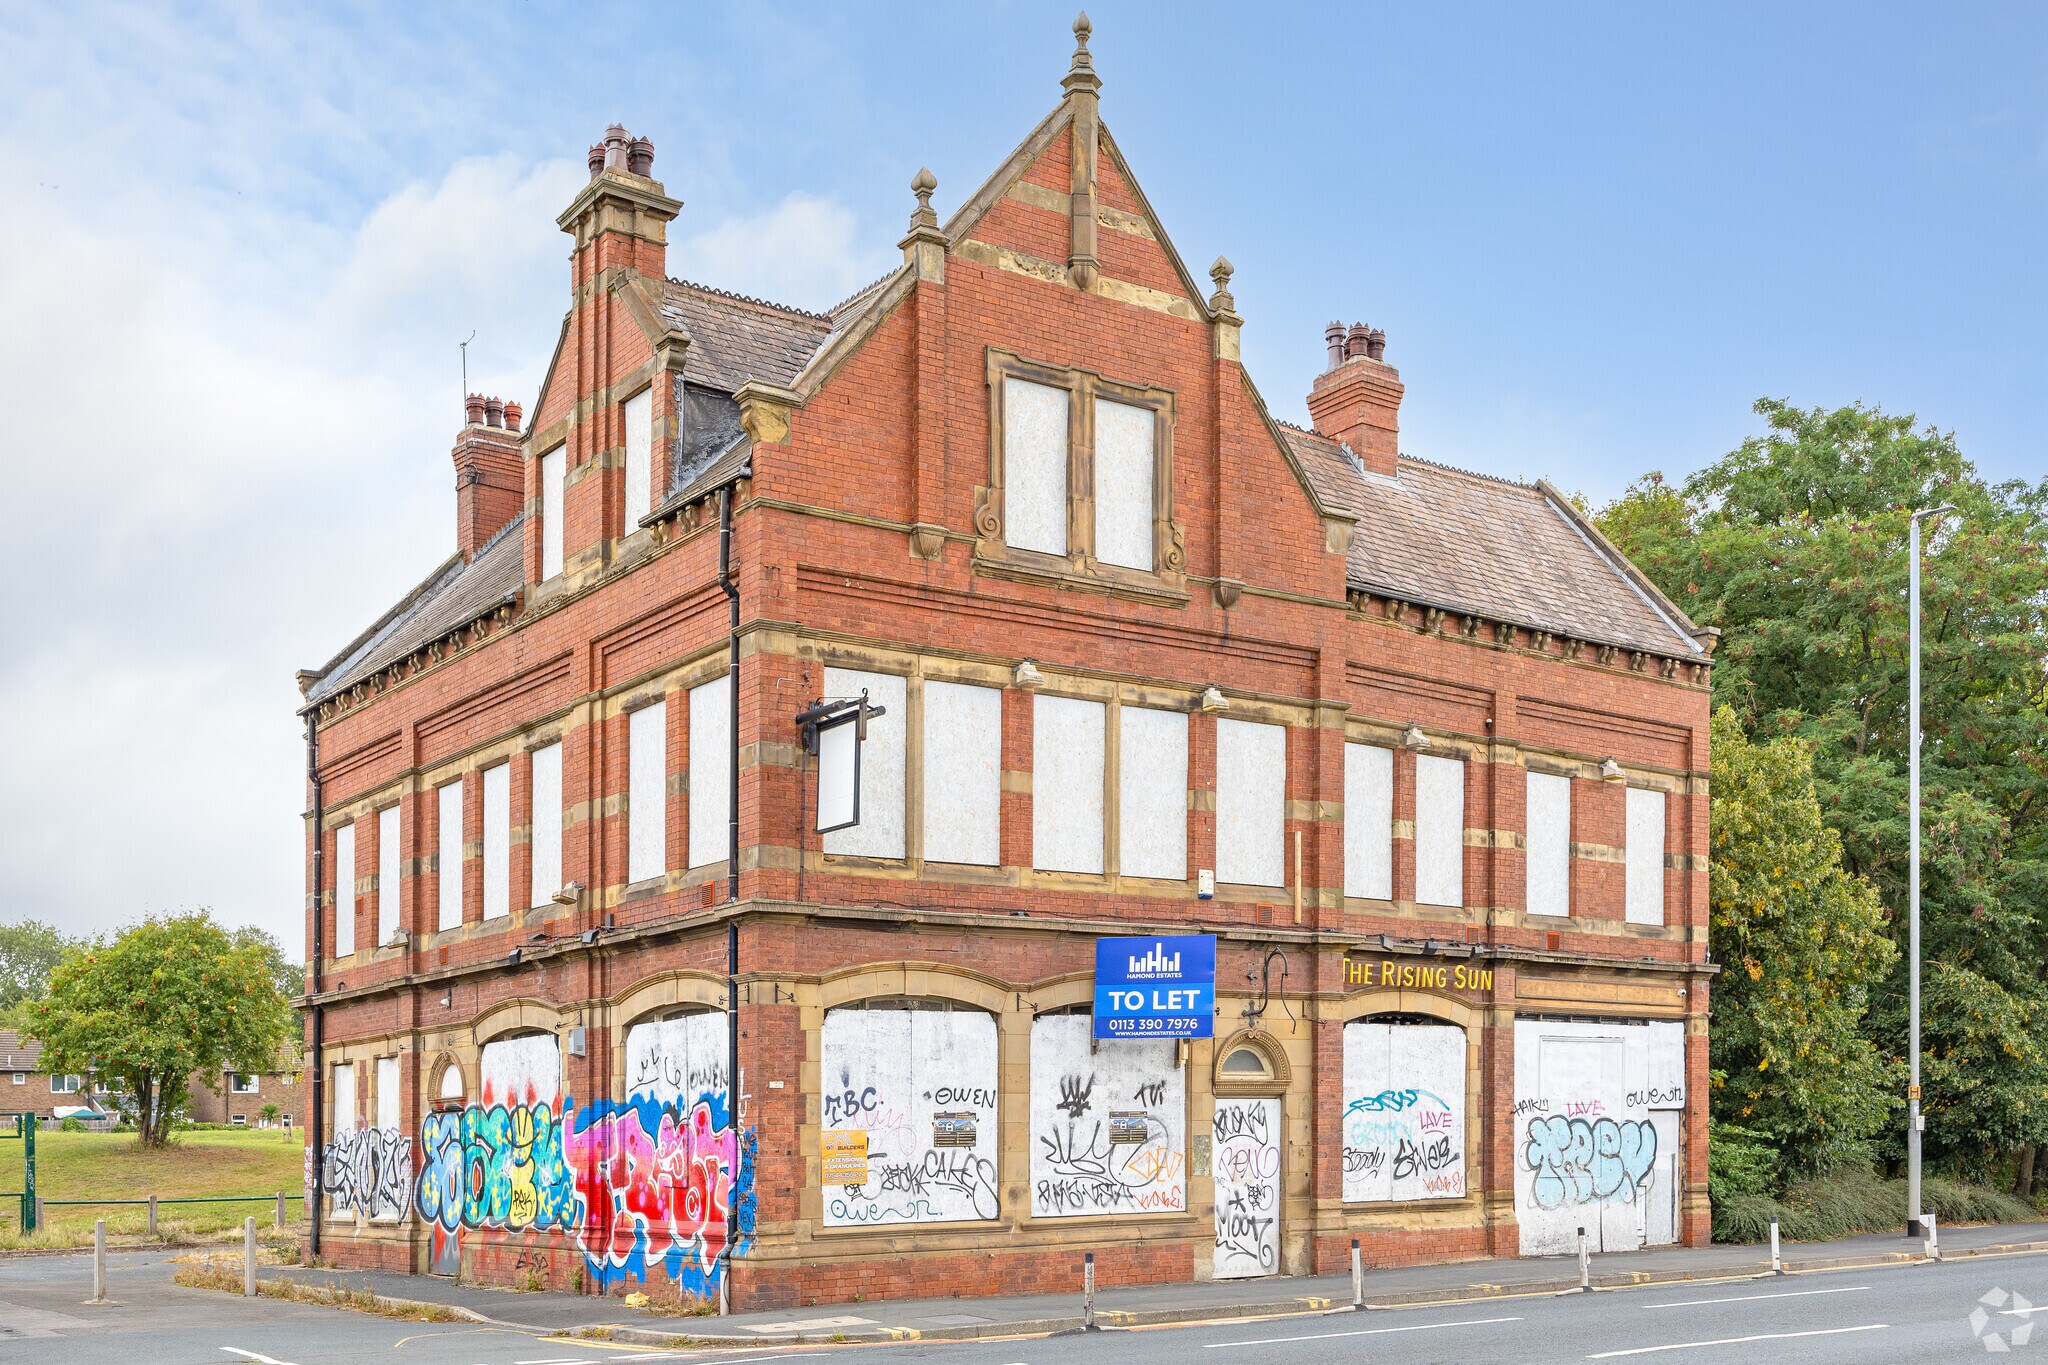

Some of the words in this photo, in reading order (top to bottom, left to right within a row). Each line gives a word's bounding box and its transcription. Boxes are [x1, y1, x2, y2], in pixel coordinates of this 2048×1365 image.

[1108, 990, 1145, 1011] TO
[1152, 989, 1201, 1010] LET
[1109, 1019, 1135, 1030] 0113
[1138, 1018, 1163, 1030] 390
[1166, 1018, 1198, 1030] 7976
[1910, 1086, 1919, 1098] H
